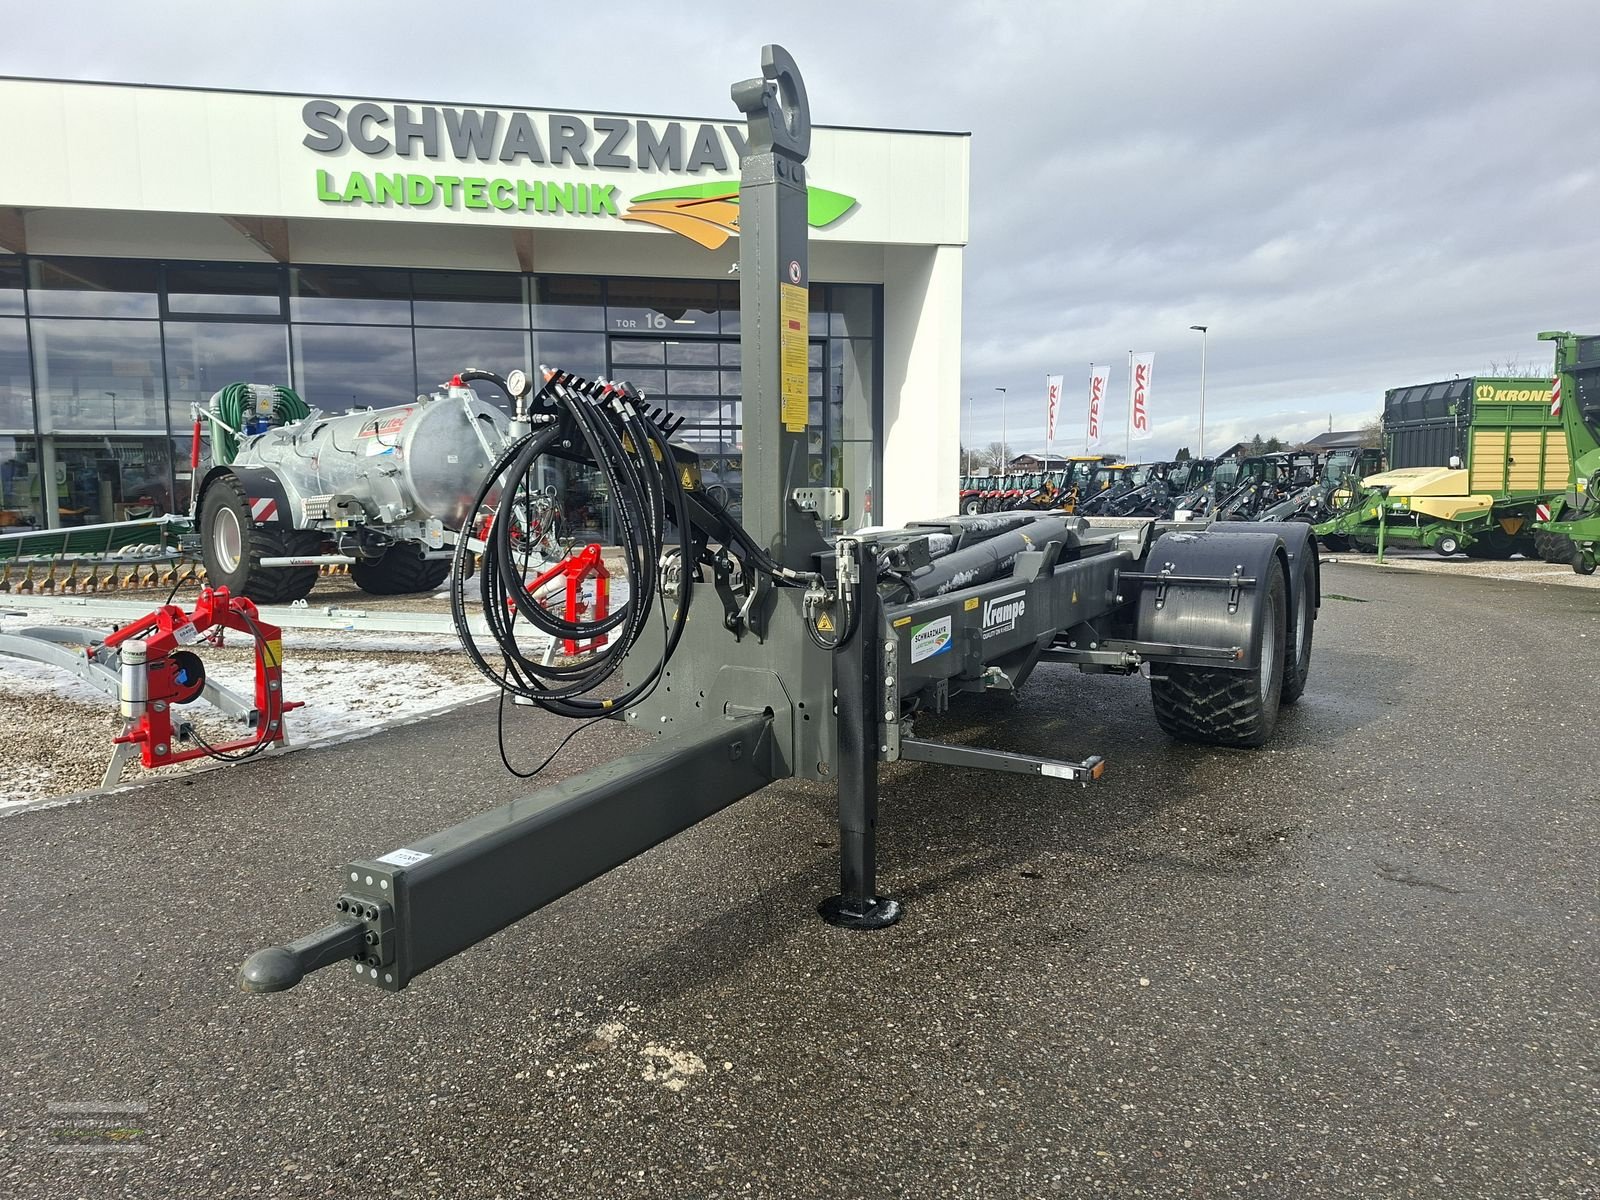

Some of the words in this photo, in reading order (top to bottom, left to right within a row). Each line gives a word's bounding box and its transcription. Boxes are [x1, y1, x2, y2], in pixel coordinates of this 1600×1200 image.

[316, 168, 618, 216] LANDTECHNIK
[615, 319, 637, 328] TOR
[645, 312, 667, 329] 16
[1089, 376, 1102, 439] STEYR
[1133, 364, 1146, 431] STEYR
[1494, 389, 1553, 402] KRONE
[982, 590, 1026, 630] Krampe
[914, 625, 947, 643] SCHWARZMAYR
